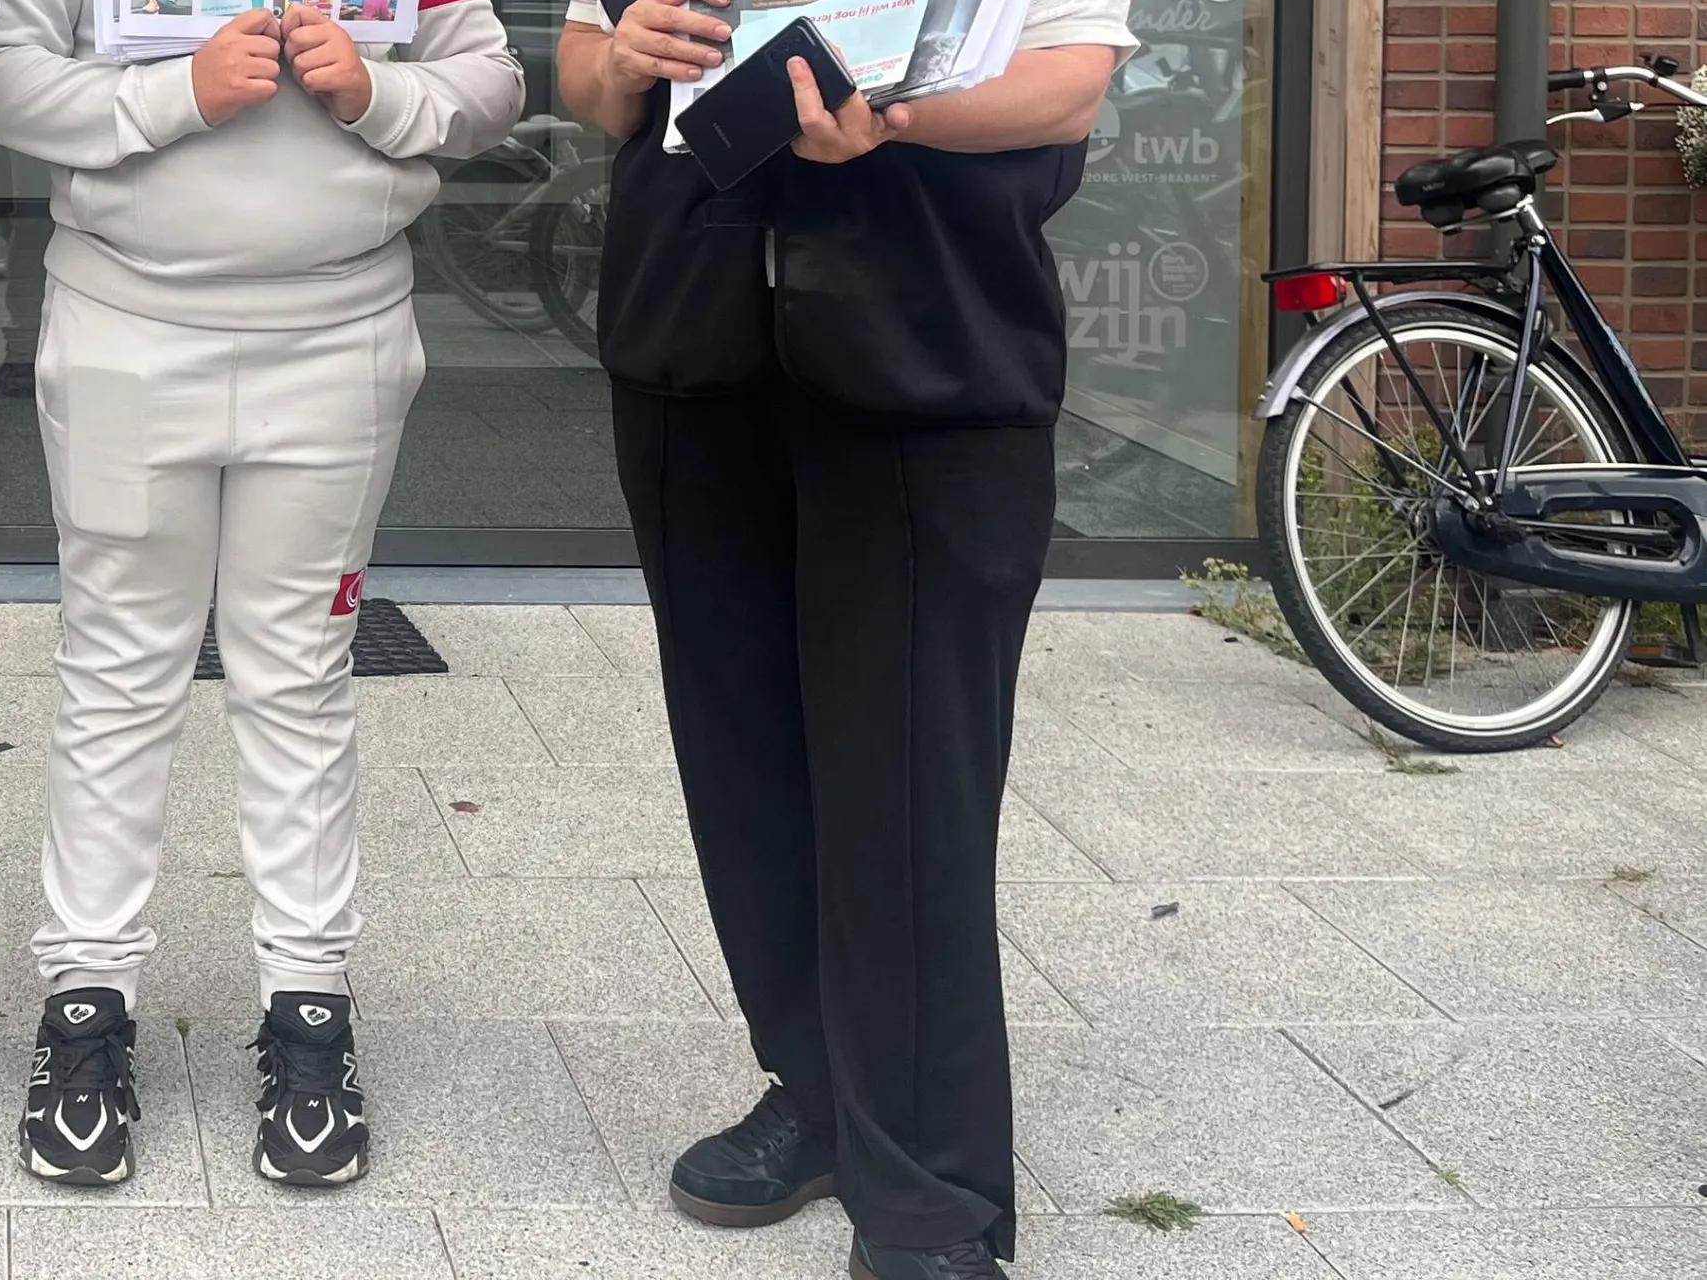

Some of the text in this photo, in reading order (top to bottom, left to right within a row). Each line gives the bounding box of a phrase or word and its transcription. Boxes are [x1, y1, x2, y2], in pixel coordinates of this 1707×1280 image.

[809, 14, 832, 24] lere
[833, 10, 856, 20] nog
[1134, 128, 1219, 165] twb
[1084, 173, 1216, 183] ZORG WEST-BRABANT
[1068, 305, 1187, 364] zijn
